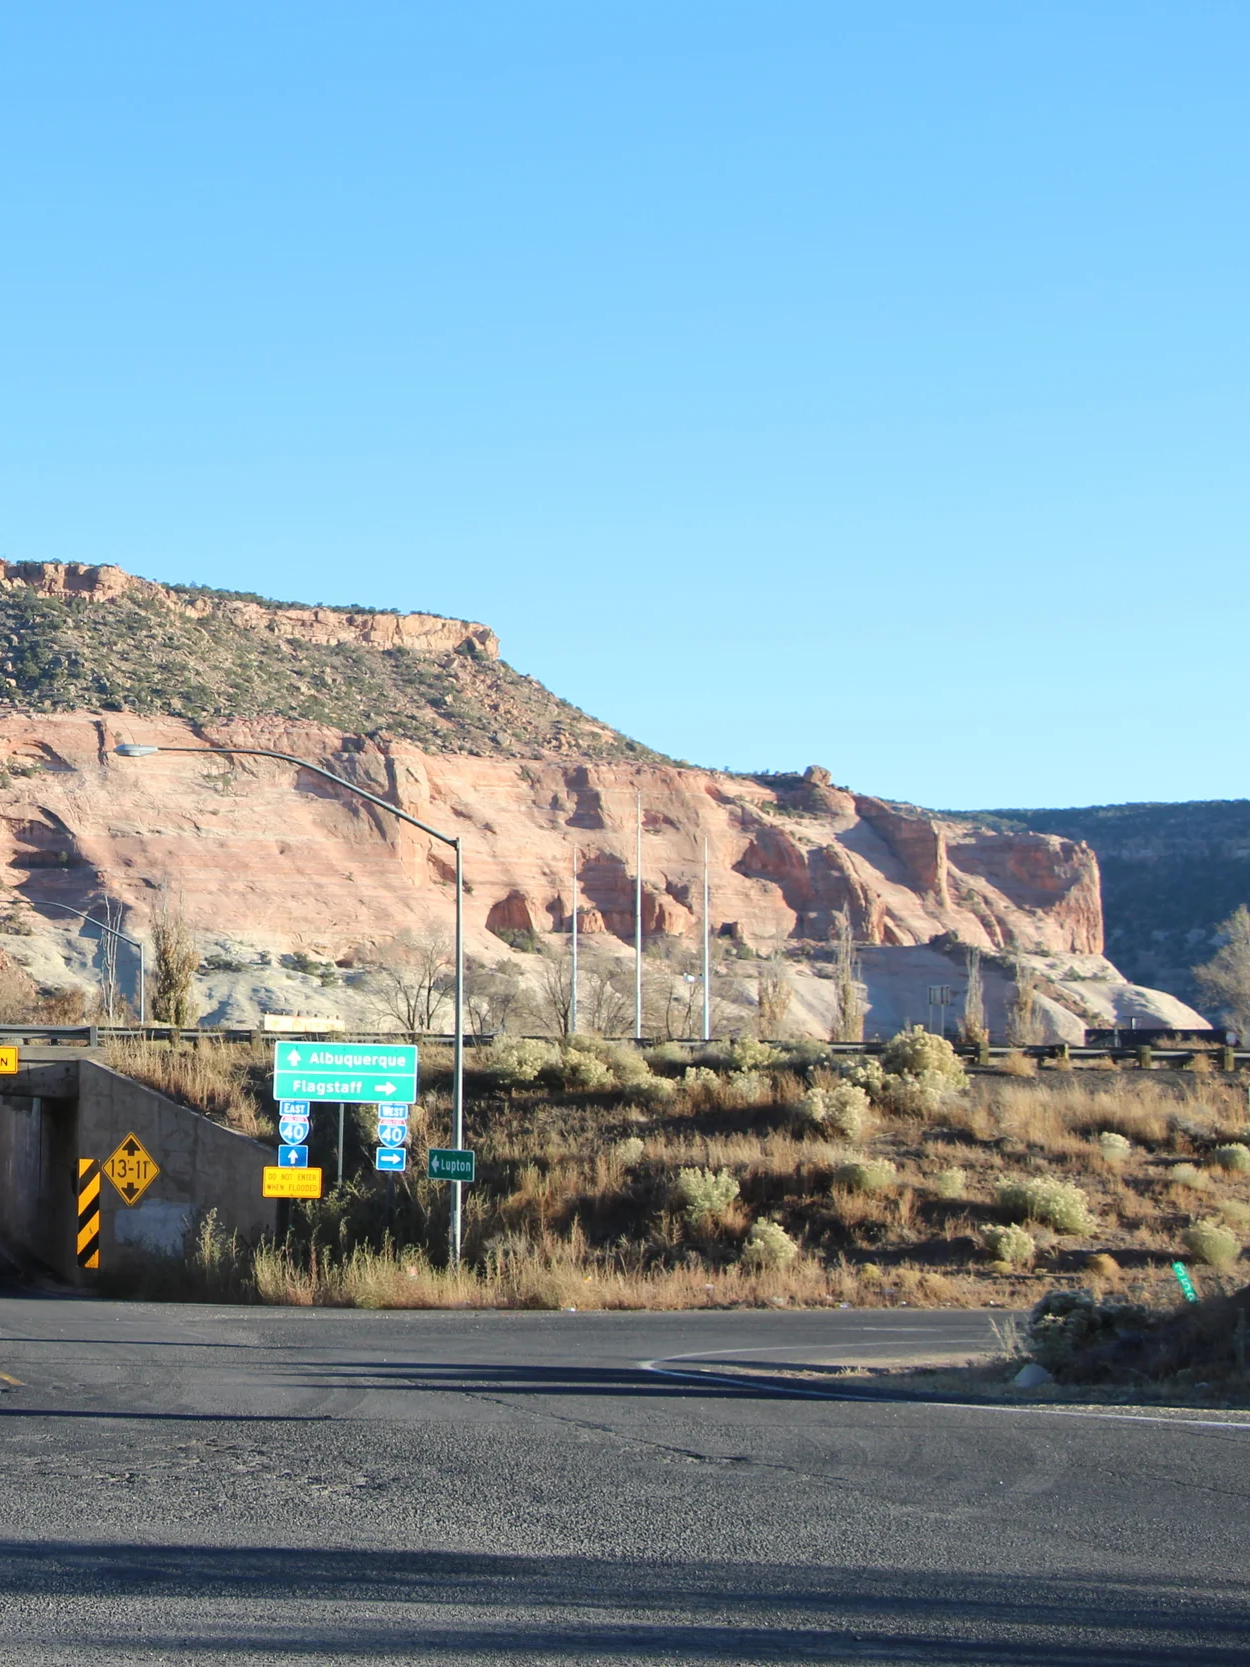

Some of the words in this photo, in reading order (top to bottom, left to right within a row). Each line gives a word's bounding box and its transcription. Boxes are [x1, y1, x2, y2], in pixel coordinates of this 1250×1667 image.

[309, 1051, 407, 1069] Albuquerque
[293, 1079, 363, 1096] Flagstaff
[283, 1102, 306, 1114] EAST
[382, 1105, 404, 1117] WEST
[282, 1124, 305, 1140] 40
[381, 1127, 403, 1143] 40
[441, 1158, 472, 1174] Lupton
[267, 1172, 277, 1181] DO
[280, 1173, 294, 1181] NOT
[297, 1173, 317, 1181] ENTER
[266, 1183, 285, 1191] WHEN
[288, 1183, 318, 1192] FLOODED
